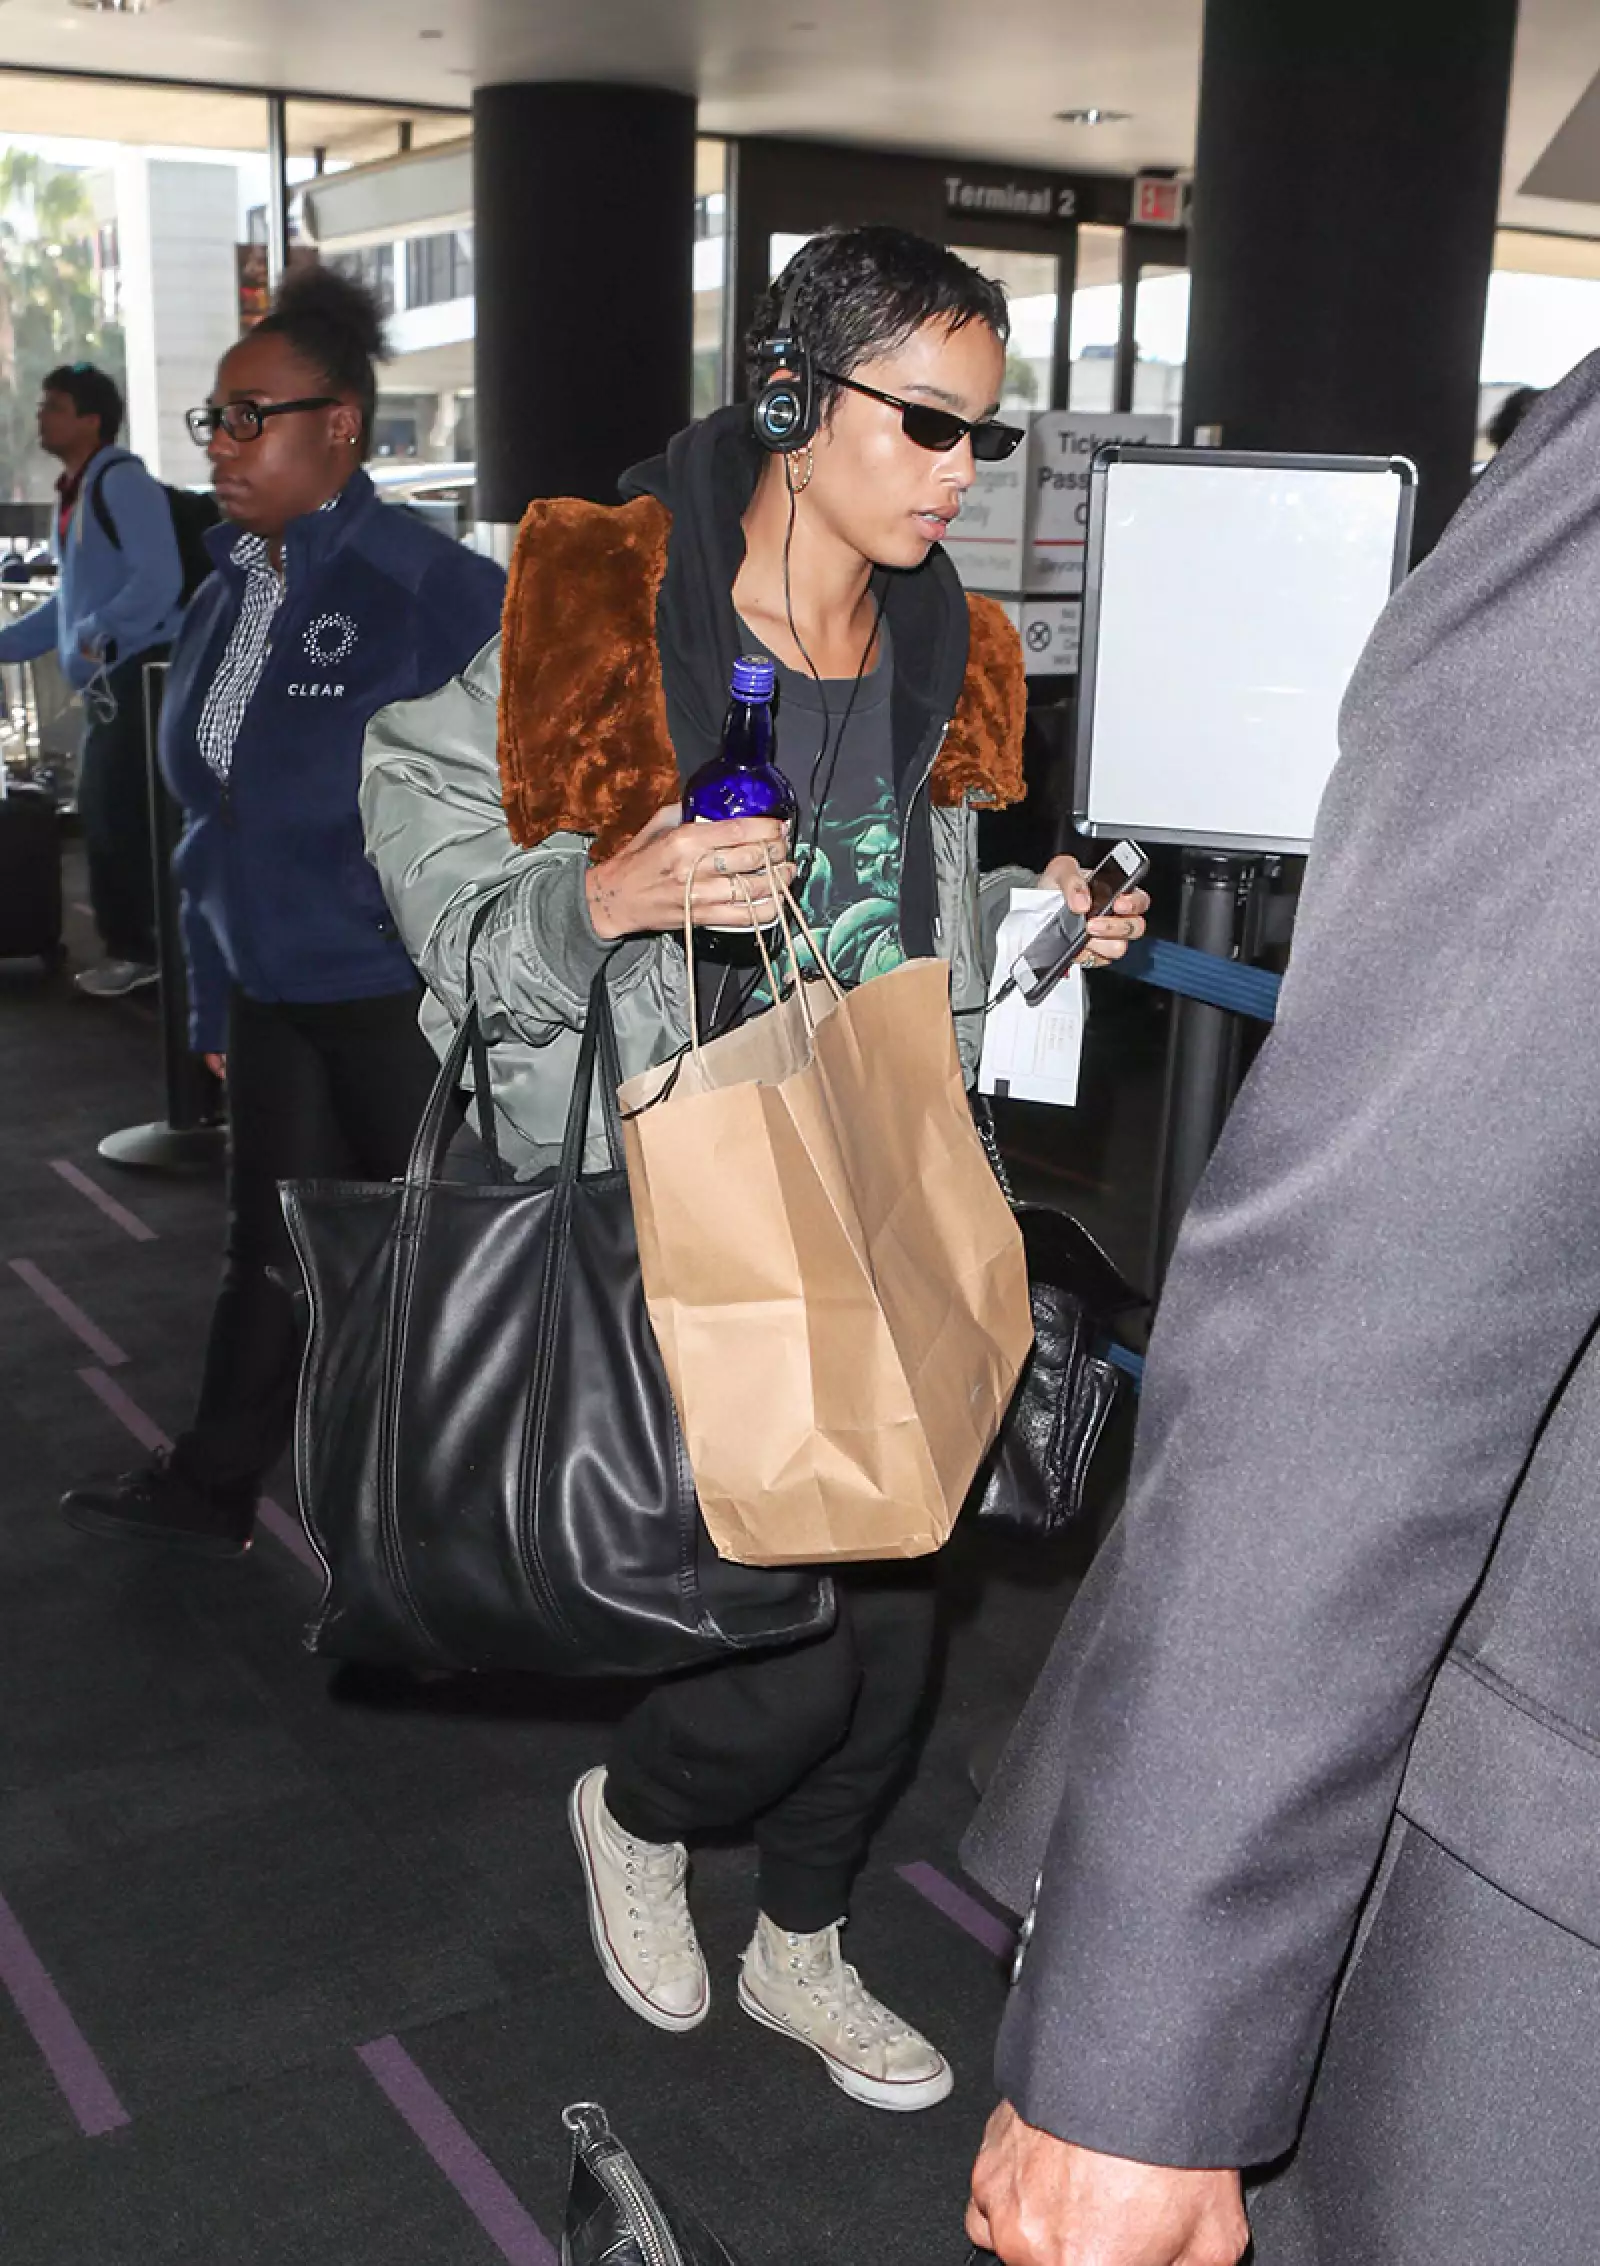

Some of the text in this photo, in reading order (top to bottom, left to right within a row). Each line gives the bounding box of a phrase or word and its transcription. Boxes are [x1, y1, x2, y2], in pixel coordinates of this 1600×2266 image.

[945, 178, 1075, 215] Terminal 2
[288, 683, 345, 697] CLEAR
